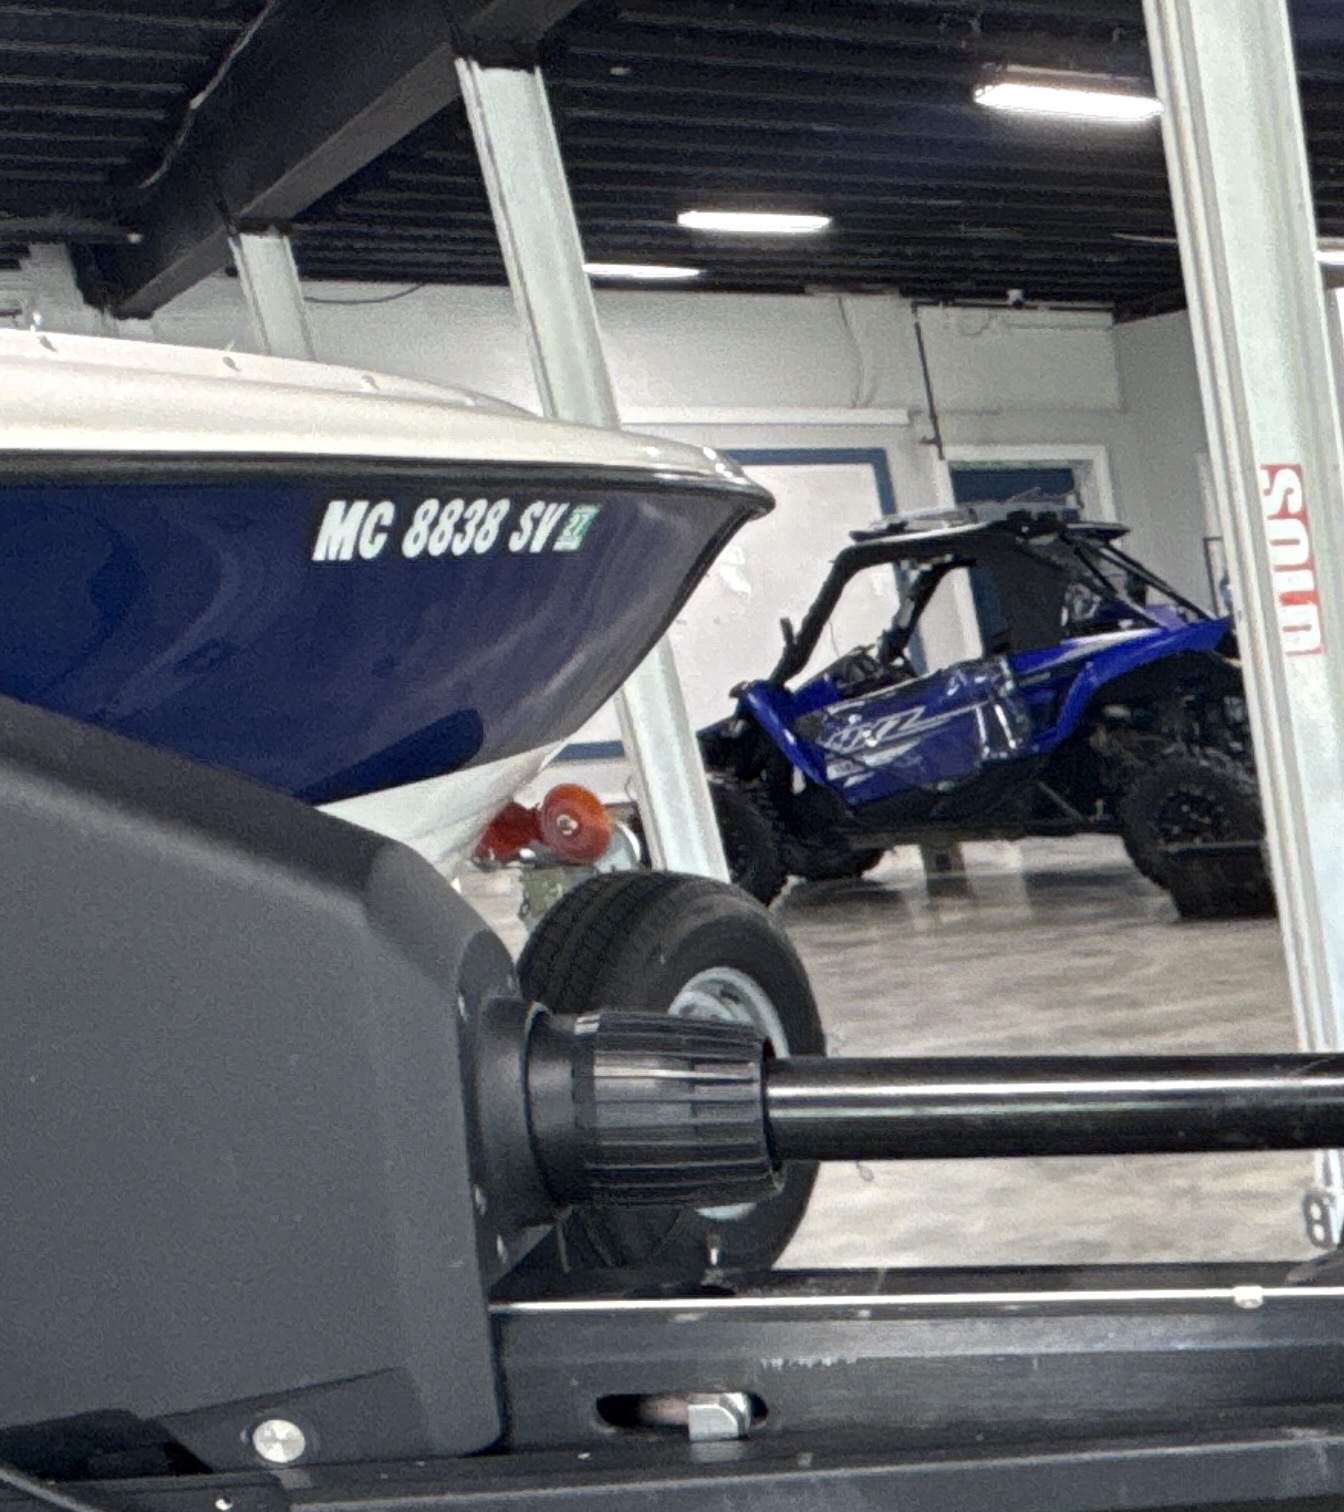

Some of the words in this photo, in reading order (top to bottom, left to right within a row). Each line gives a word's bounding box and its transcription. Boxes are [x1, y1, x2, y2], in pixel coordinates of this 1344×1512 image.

[312, 500, 395, 560] MC
[402, 498, 510, 558] 8838
[508, 501, 570, 552] SV
